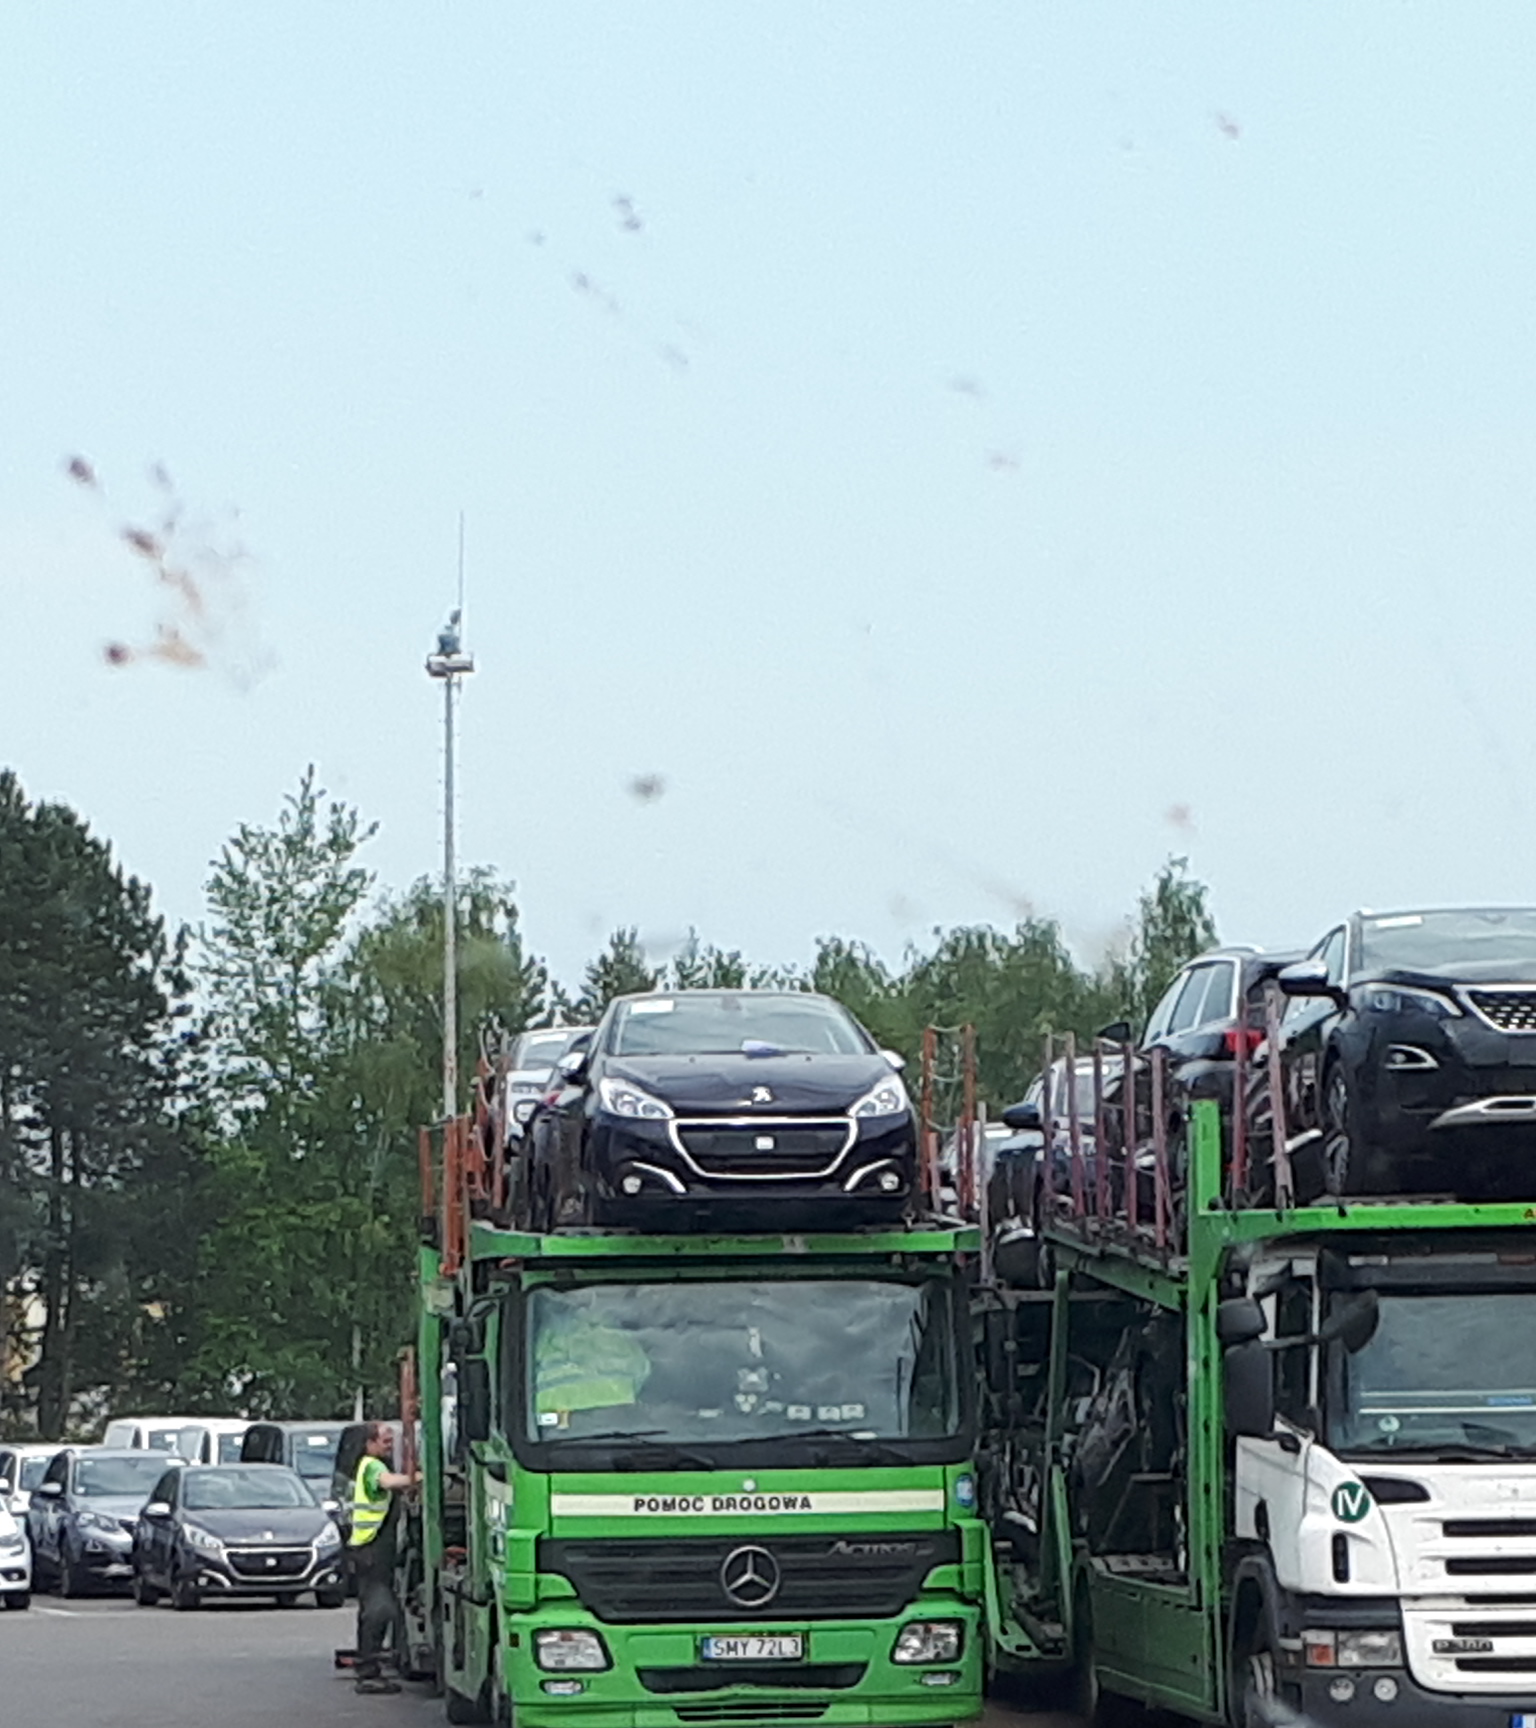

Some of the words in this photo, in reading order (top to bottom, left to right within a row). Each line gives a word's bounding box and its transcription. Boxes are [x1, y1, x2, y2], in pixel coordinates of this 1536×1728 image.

[634, 1495, 705, 1511] POMOC
[712, 1496, 812, 1511] DROGOWA
[1337, 1486, 1364, 1516] IV
[714, 1640, 748, 1656] SMY
